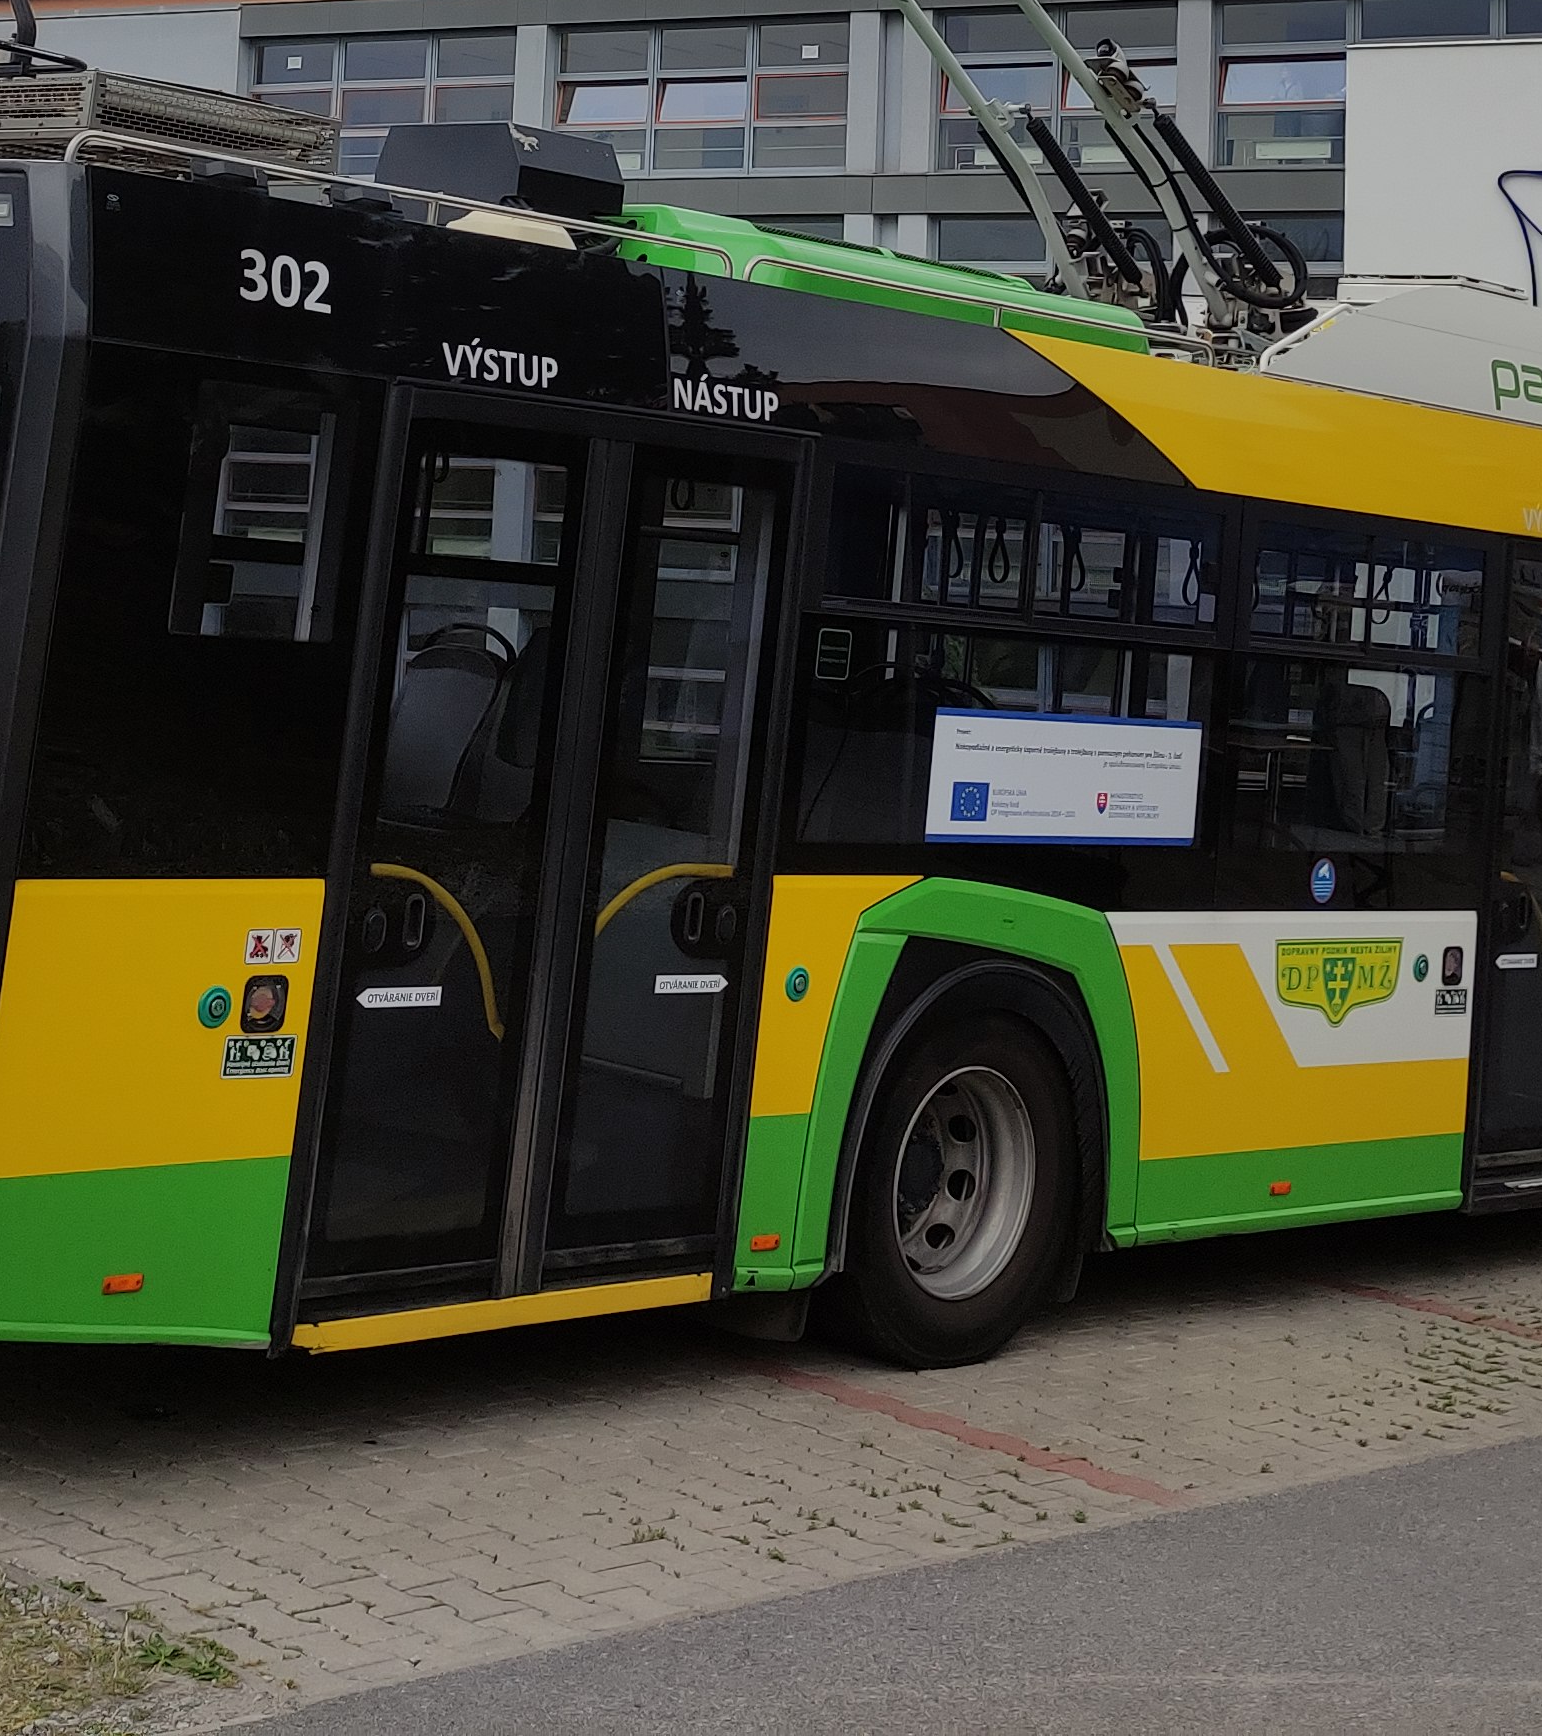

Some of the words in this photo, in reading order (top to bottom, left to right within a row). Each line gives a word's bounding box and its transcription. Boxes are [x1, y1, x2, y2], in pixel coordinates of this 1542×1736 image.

[239, 248, 332, 315] 302
[442, 337, 559, 389] VÝSTUP
[672, 373, 780, 422] NÁSTUP
